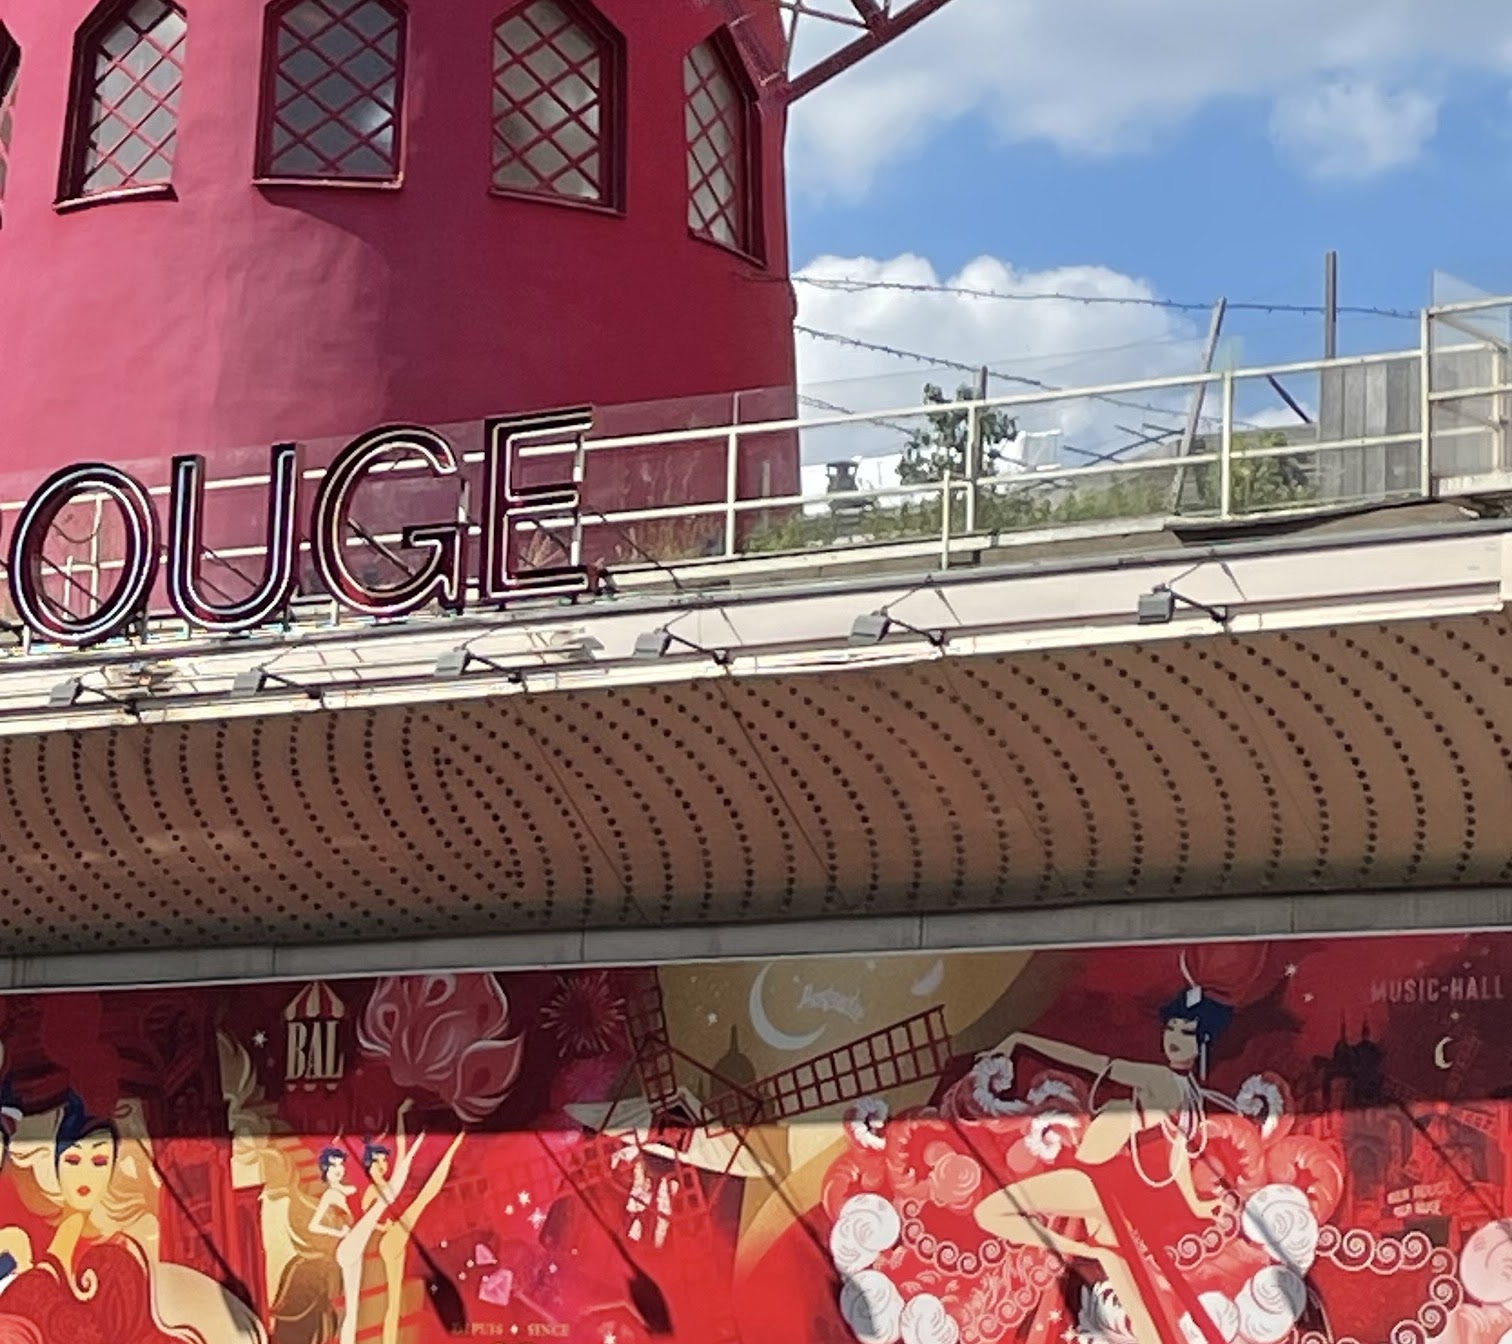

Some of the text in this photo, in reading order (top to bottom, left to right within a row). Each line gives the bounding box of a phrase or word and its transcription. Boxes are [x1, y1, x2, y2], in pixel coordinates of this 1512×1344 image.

[1371, 975, 1504, 1002] MUSIC-HALL
[285, 1021, 345, 1080] BAL
[527, 1323, 570, 1337] SINCE
